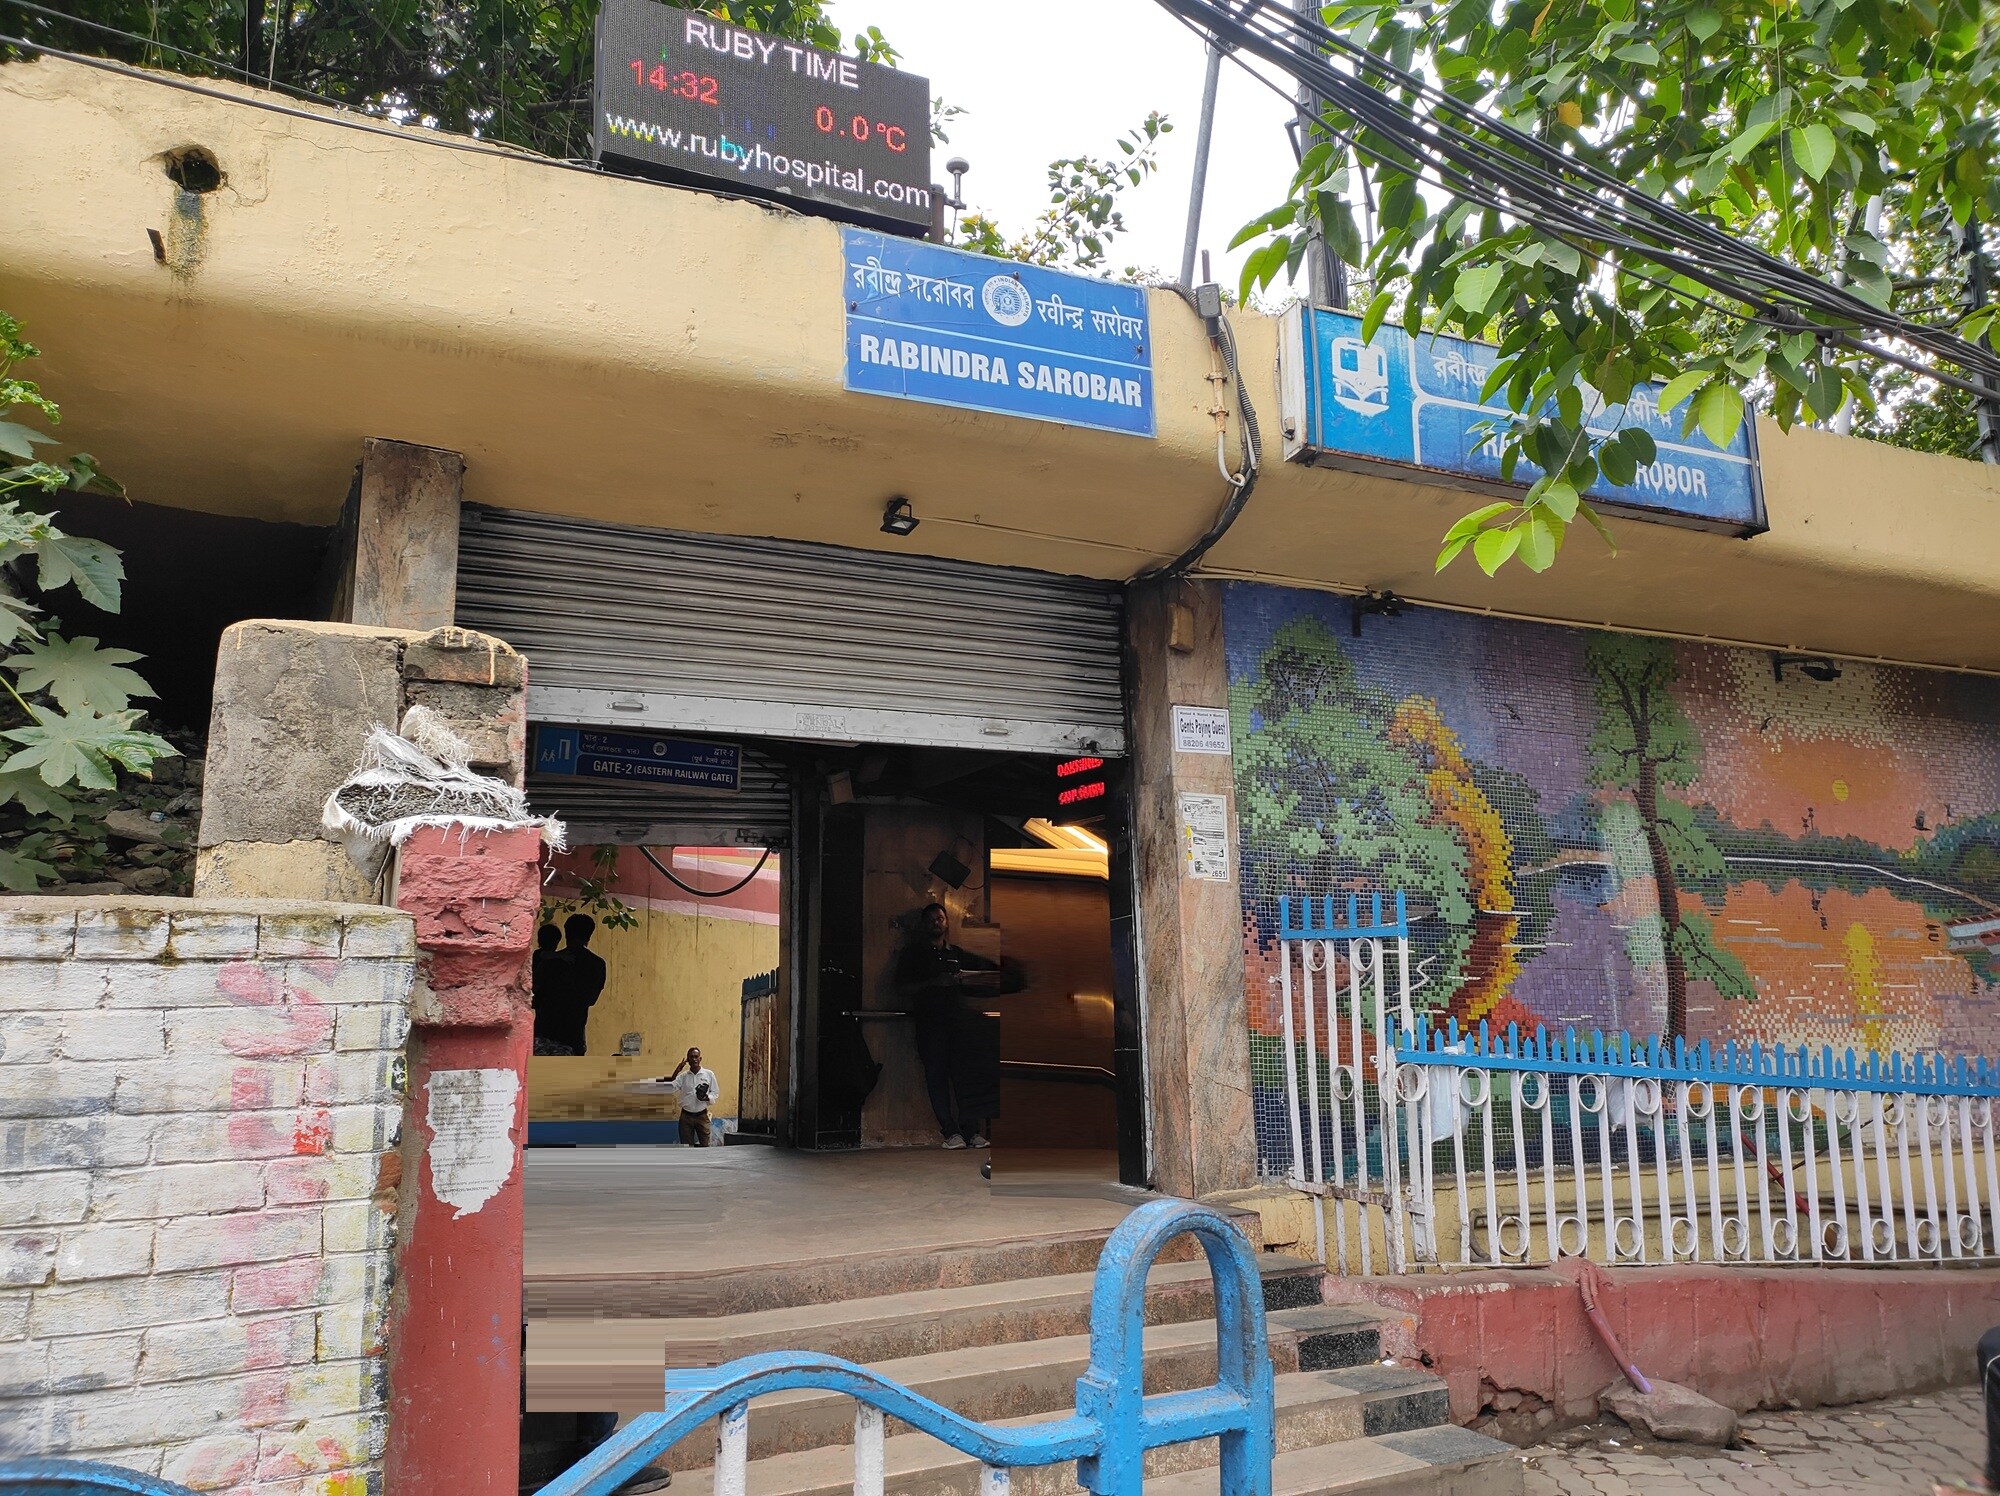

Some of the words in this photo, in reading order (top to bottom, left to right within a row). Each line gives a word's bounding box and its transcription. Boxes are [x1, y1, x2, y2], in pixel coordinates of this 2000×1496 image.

[685, 18, 777, 65] RUBY
[784, 46, 859, 89] TIME
[630, 59, 719, 106] 14:32
[606, 113, 930, 208] www.rubyhospital.com
[850, 256, 902, 299] রবীন্দ্র
[905, 273, 975, 310] সরোবর
[1035, 294, 1084, 331] रवीन्द्र
[1090, 306, 1143, 341] सरोवर
[860, 334, 1009, 386] RABINDRA
[1018, 361, 1143, 407] SAROBAR
[1180, 717, 1195, 734] Gents
[1195, 719, 1211, 738] Paying
[1212, 720, 1226, 735] Guest
[593, 760, 632, 775] GATE-2
[634, 766, 673, 777] (EASTERN
[675, 769, 710, 781] RAILWAY
[711, 772, 734, 784] GATE)
